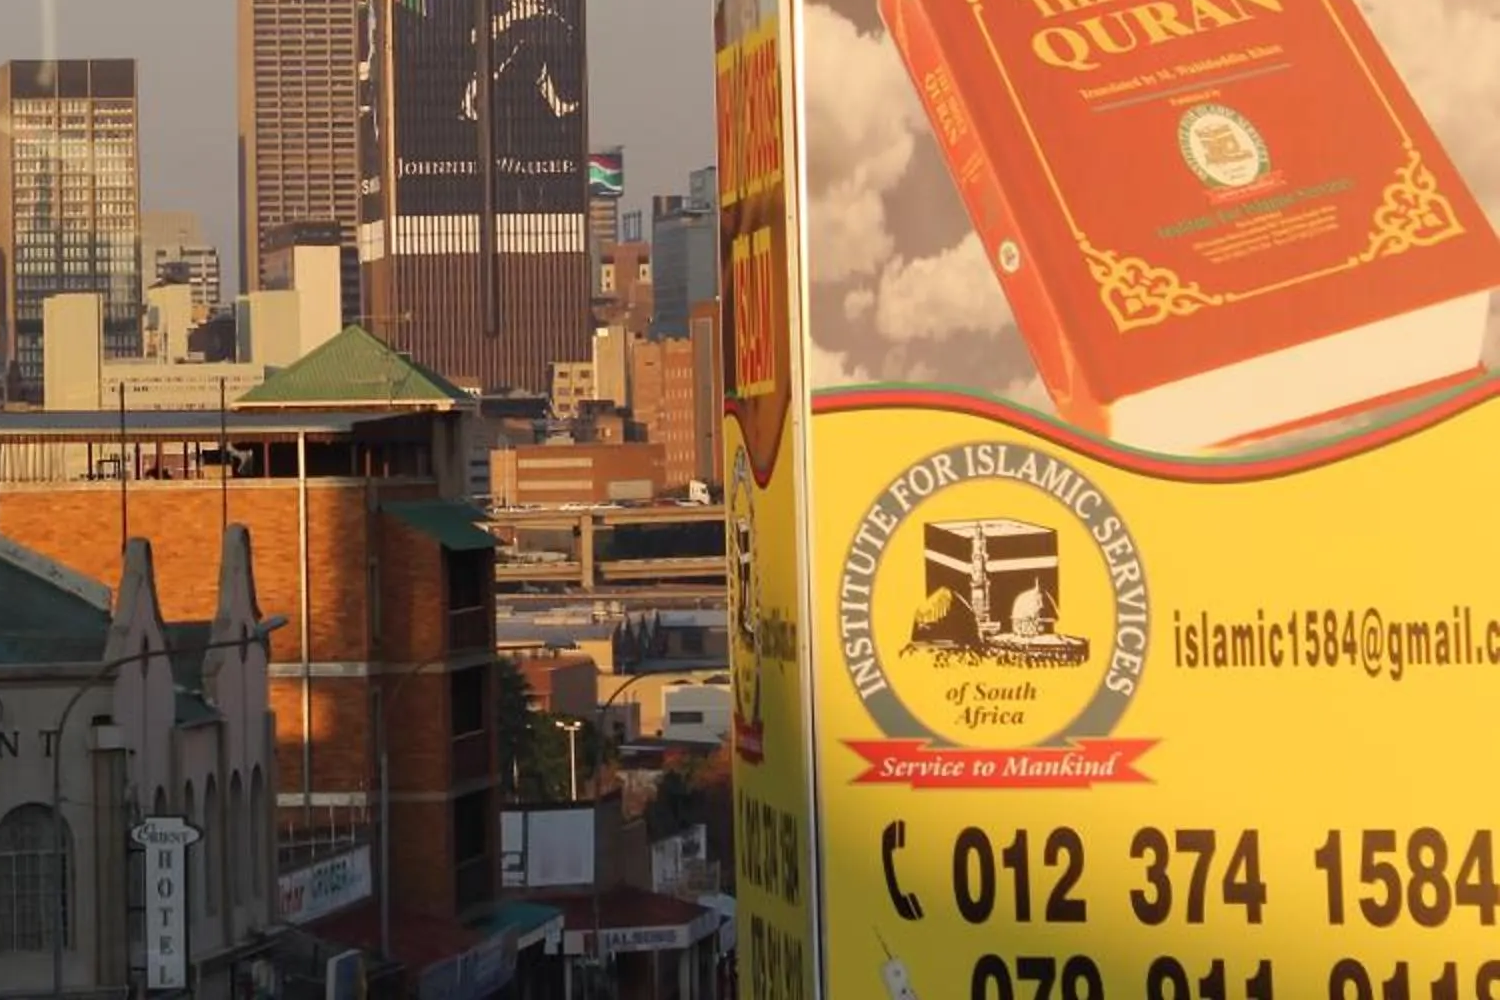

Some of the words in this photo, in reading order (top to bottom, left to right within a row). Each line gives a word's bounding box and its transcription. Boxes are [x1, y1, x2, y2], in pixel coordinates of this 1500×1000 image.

[397, 156, 479, 178] JOHNNIE
[495, 156, 578, 175] WALKER
[840, 504, 899, 700] INSTITUTE
[889, 452, 960, 513] FOR
[962, 443, 1103, 520] ISLAMIC
[1092, 515, 1148, 698] SERVICES
[944, 680, 970, 704] of
[973, 681, 1038, 702] South
[954, 704, 1026, 730] Africa
[879, 755, 966, 779] Service
[971, 756, 996, 779] to
[1001, 751, 1122, 779] Mankind
[952, 825, 1088, 925] 012
[1129, 826, 1268, 927] 374
[1314, 826, 1500, 928] 1584
[156, 849, 175, 986] HOTEL
